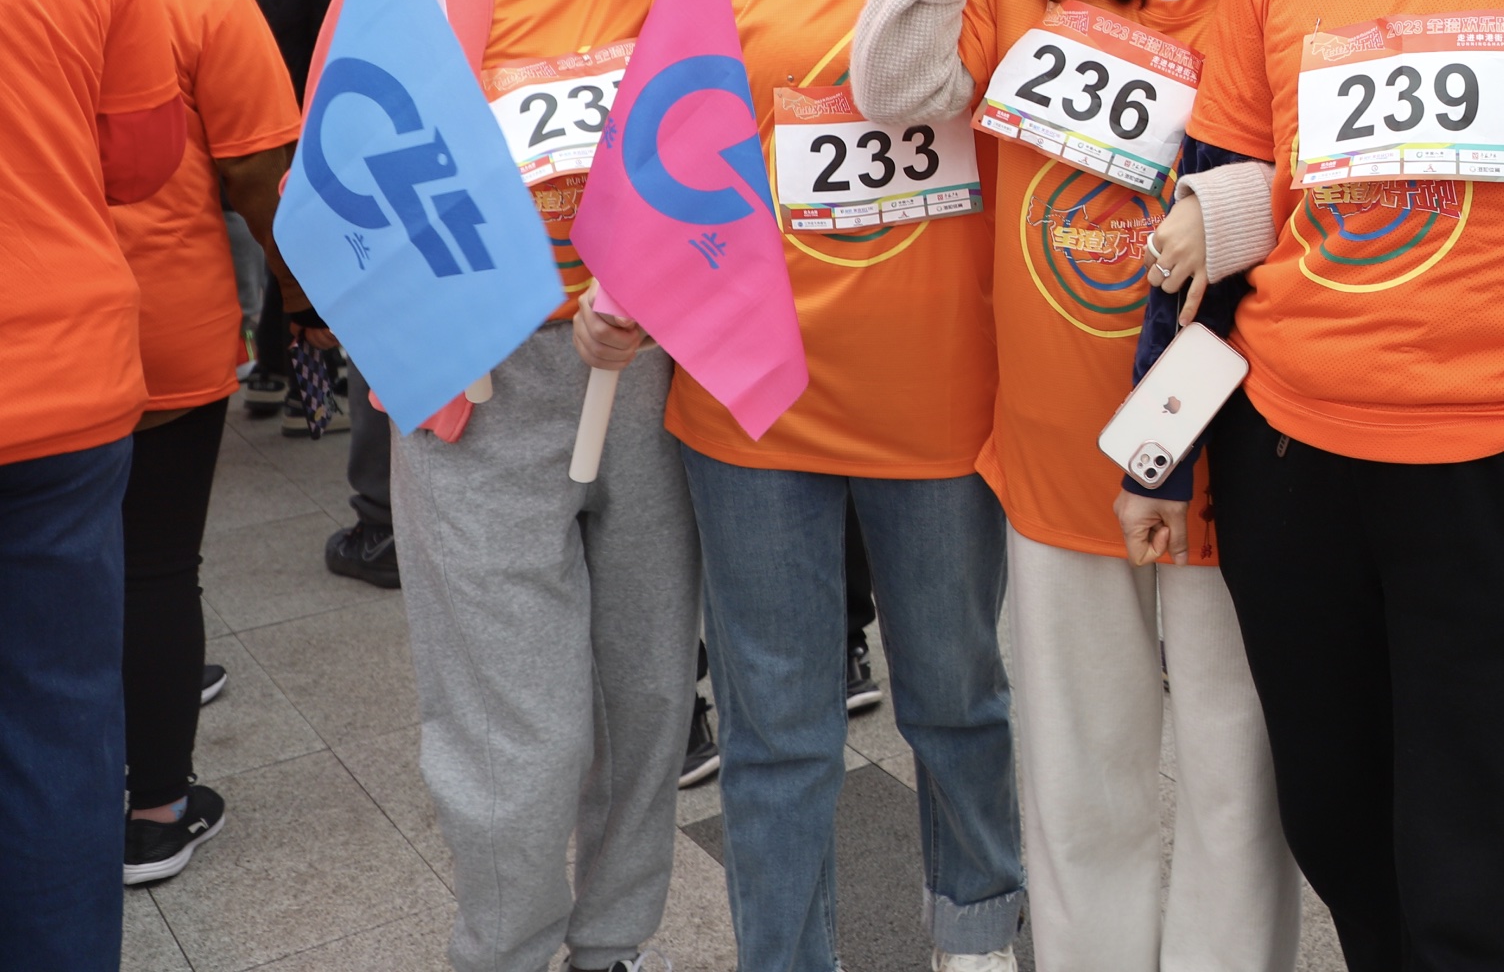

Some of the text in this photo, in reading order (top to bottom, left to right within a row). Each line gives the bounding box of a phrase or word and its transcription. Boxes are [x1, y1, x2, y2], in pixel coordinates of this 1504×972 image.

[1093, 16, 1130, 41] 2023
[1387, 19, 1423, 39] 2023
[519, 79, 622, 148] 23
[1014, 44, 1157, 141] 236
[1335, 62, 1480, 142] 239
[809, 124, 940, 193] 233
